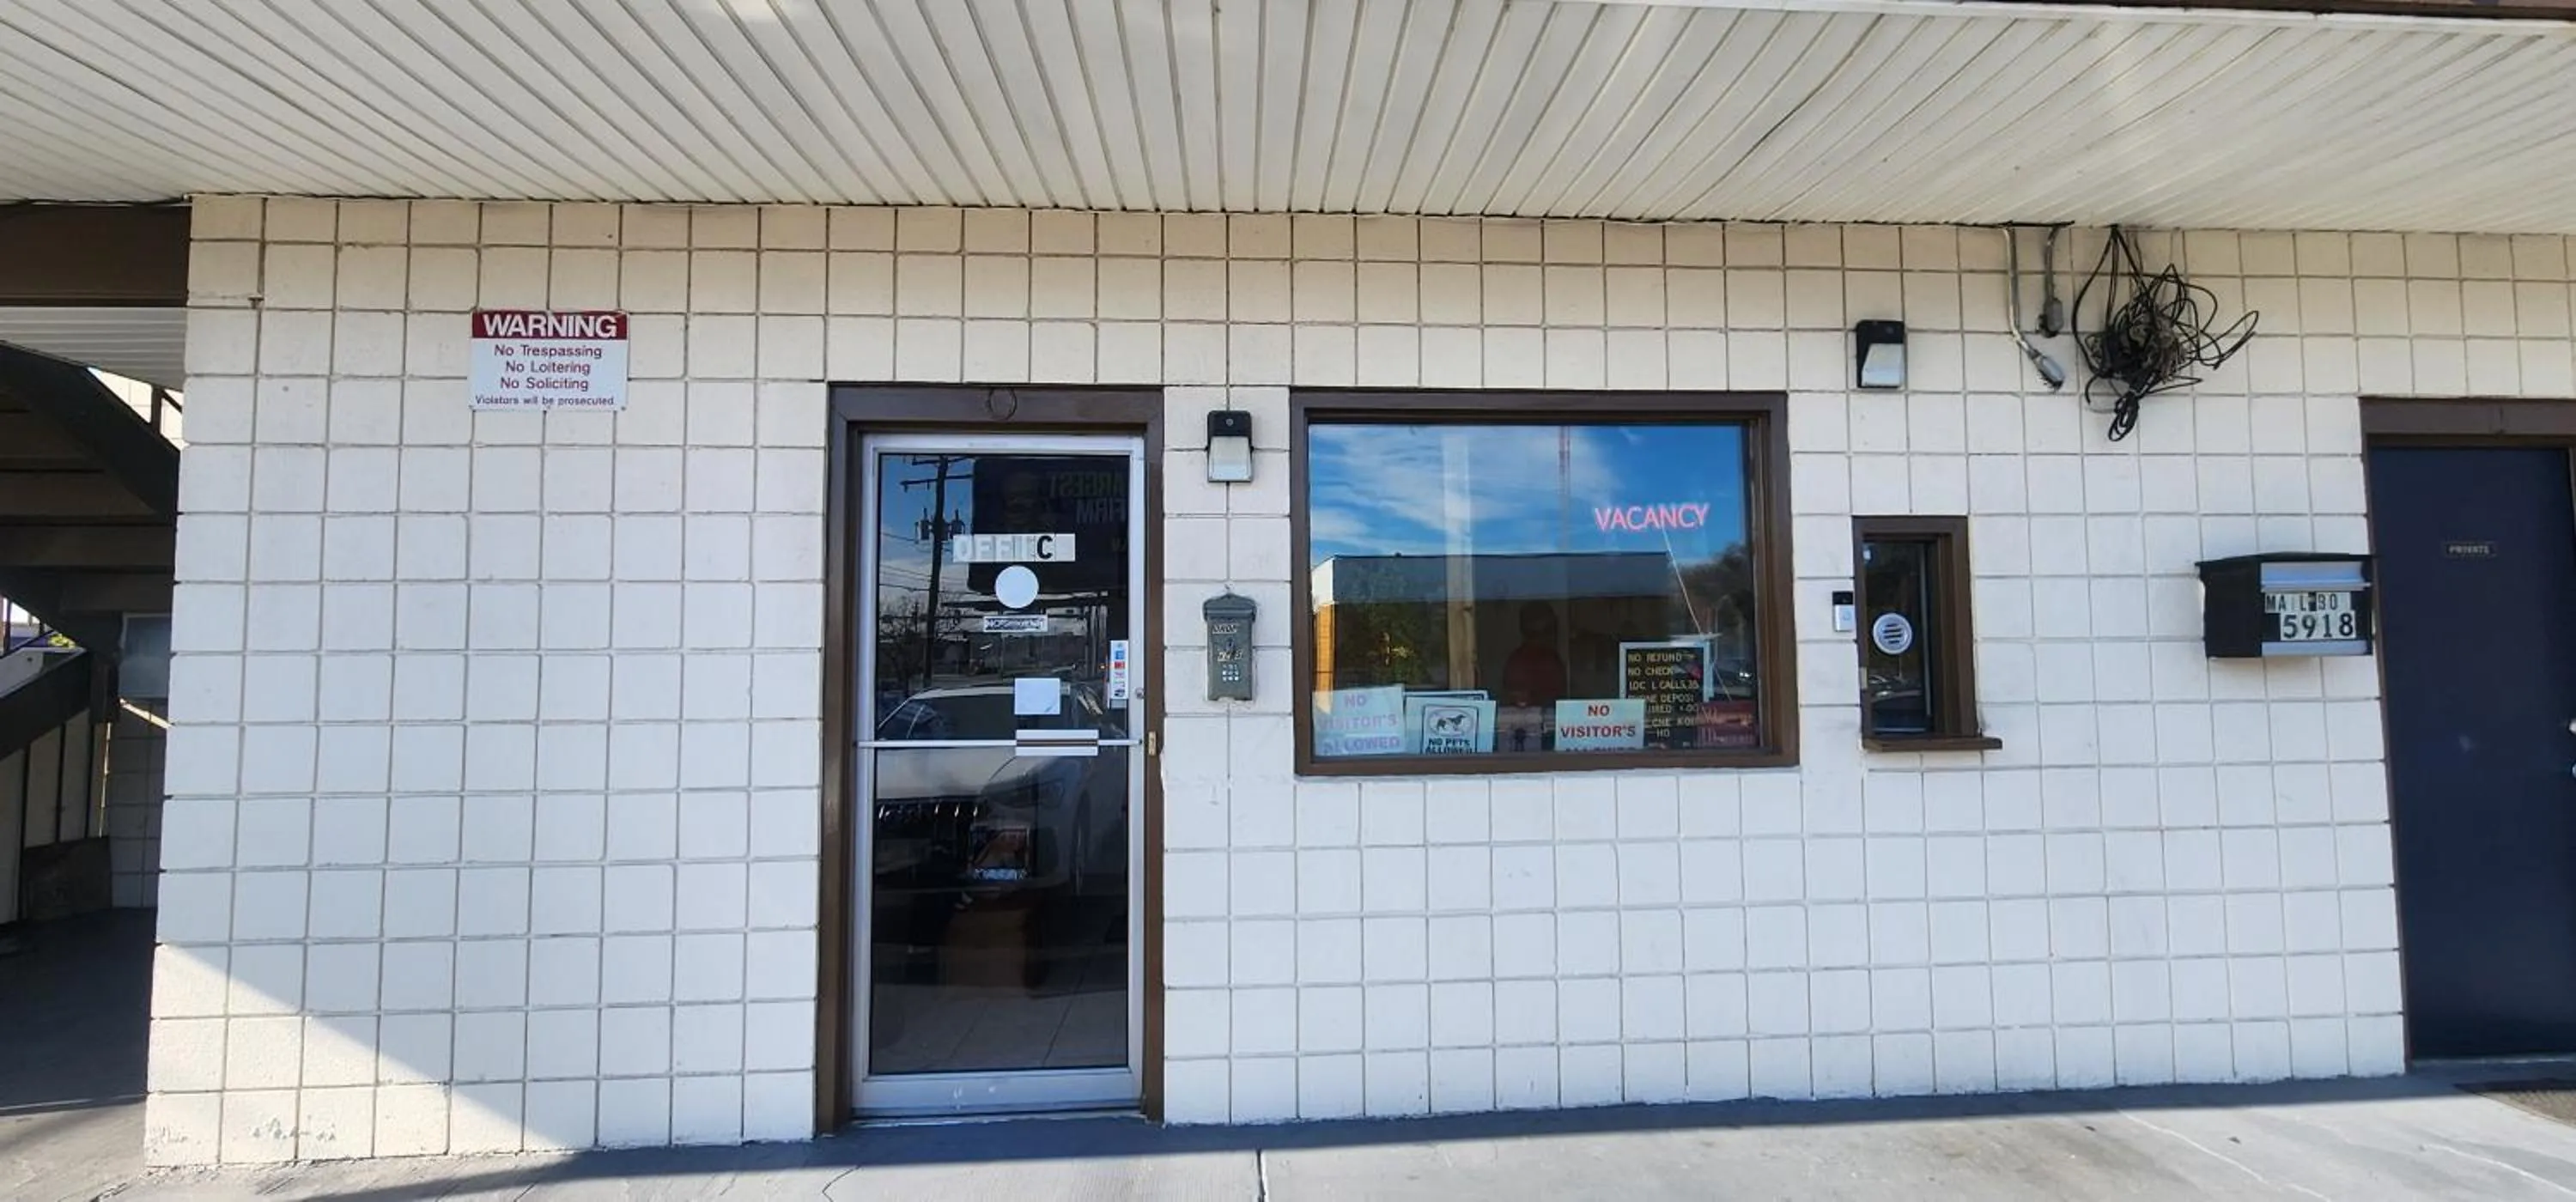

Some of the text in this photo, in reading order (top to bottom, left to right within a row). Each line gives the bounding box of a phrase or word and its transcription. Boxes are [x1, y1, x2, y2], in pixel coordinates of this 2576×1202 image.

[483, 313, 617, 338] WARNING
[494, 344, 603, 359] No Trespassing
[506, 361, 591, 375] No Loitering
[501, 378, 589, 392] No Soliciting
[475, 395, 519, 405] Violators
[523, 396, 538, 405] will
[542, 395, 554, 405] be
[1595, 503, 1710, 531] VACANCY
[2283, 612, 2354, 639] 5918
[1628, 653, 1642, 663] NO
[1628, 666, 1642, 677] NO
[1344, 693, 1368, 707] NO
[1588, 705, 1610, 716] NO
[1319, 713, 1397, 730] VISITOR'S
[1560, 725, 1636, 738] VISITOR'S
[1323, 736, 1400, 754] ALLOWED
[1428, 738, 1471, 746] NO PETS
